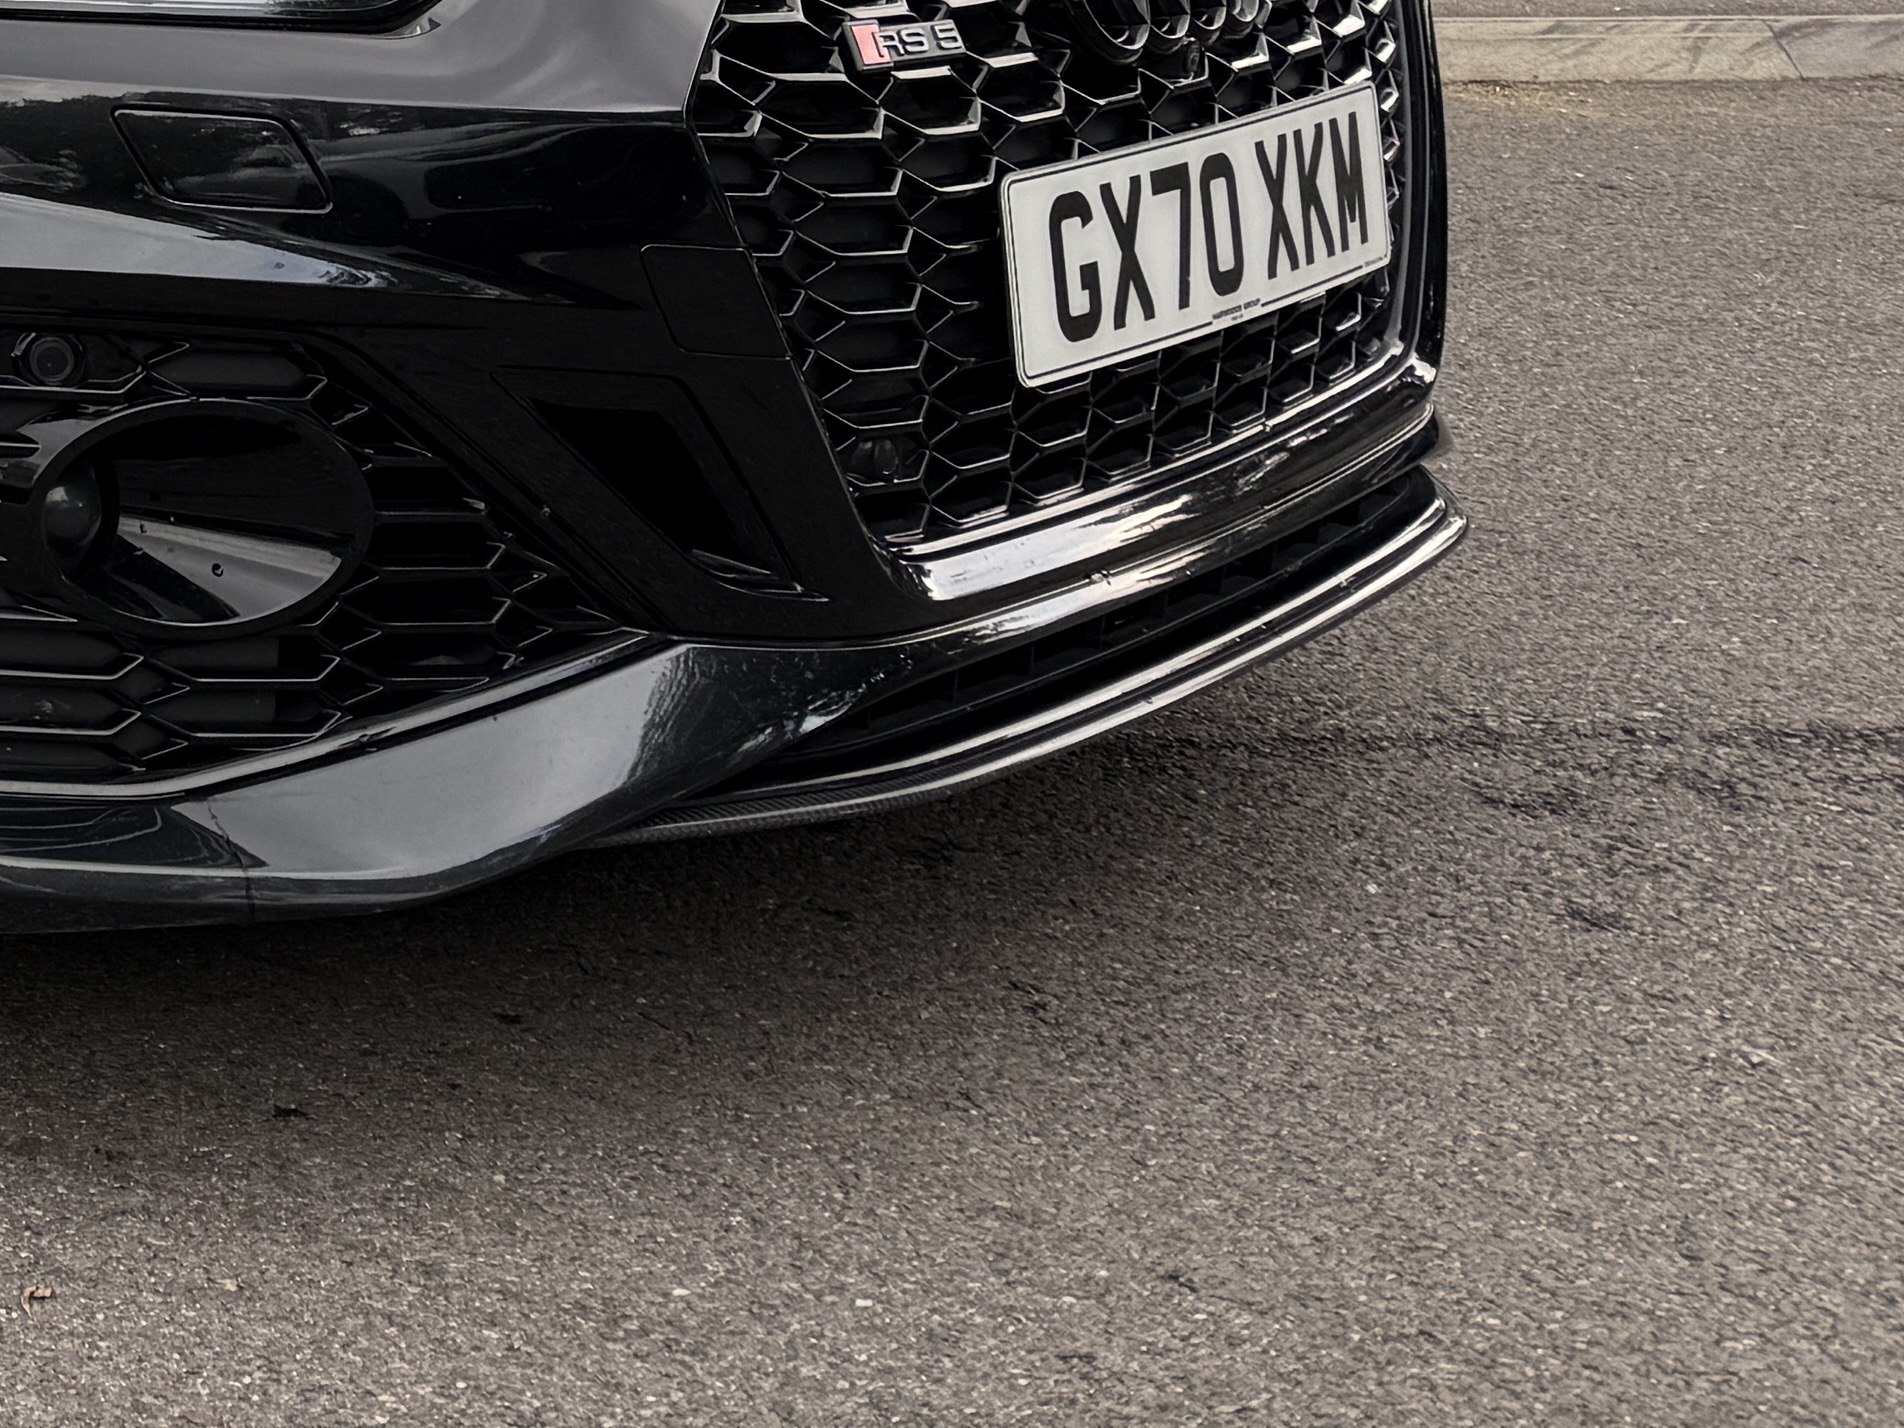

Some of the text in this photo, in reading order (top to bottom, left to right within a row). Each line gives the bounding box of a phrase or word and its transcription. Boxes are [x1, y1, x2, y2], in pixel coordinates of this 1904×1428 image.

[872, 24, 963, 58] RS 5
[1048, 111, 1369, 343] GX70 XKM
